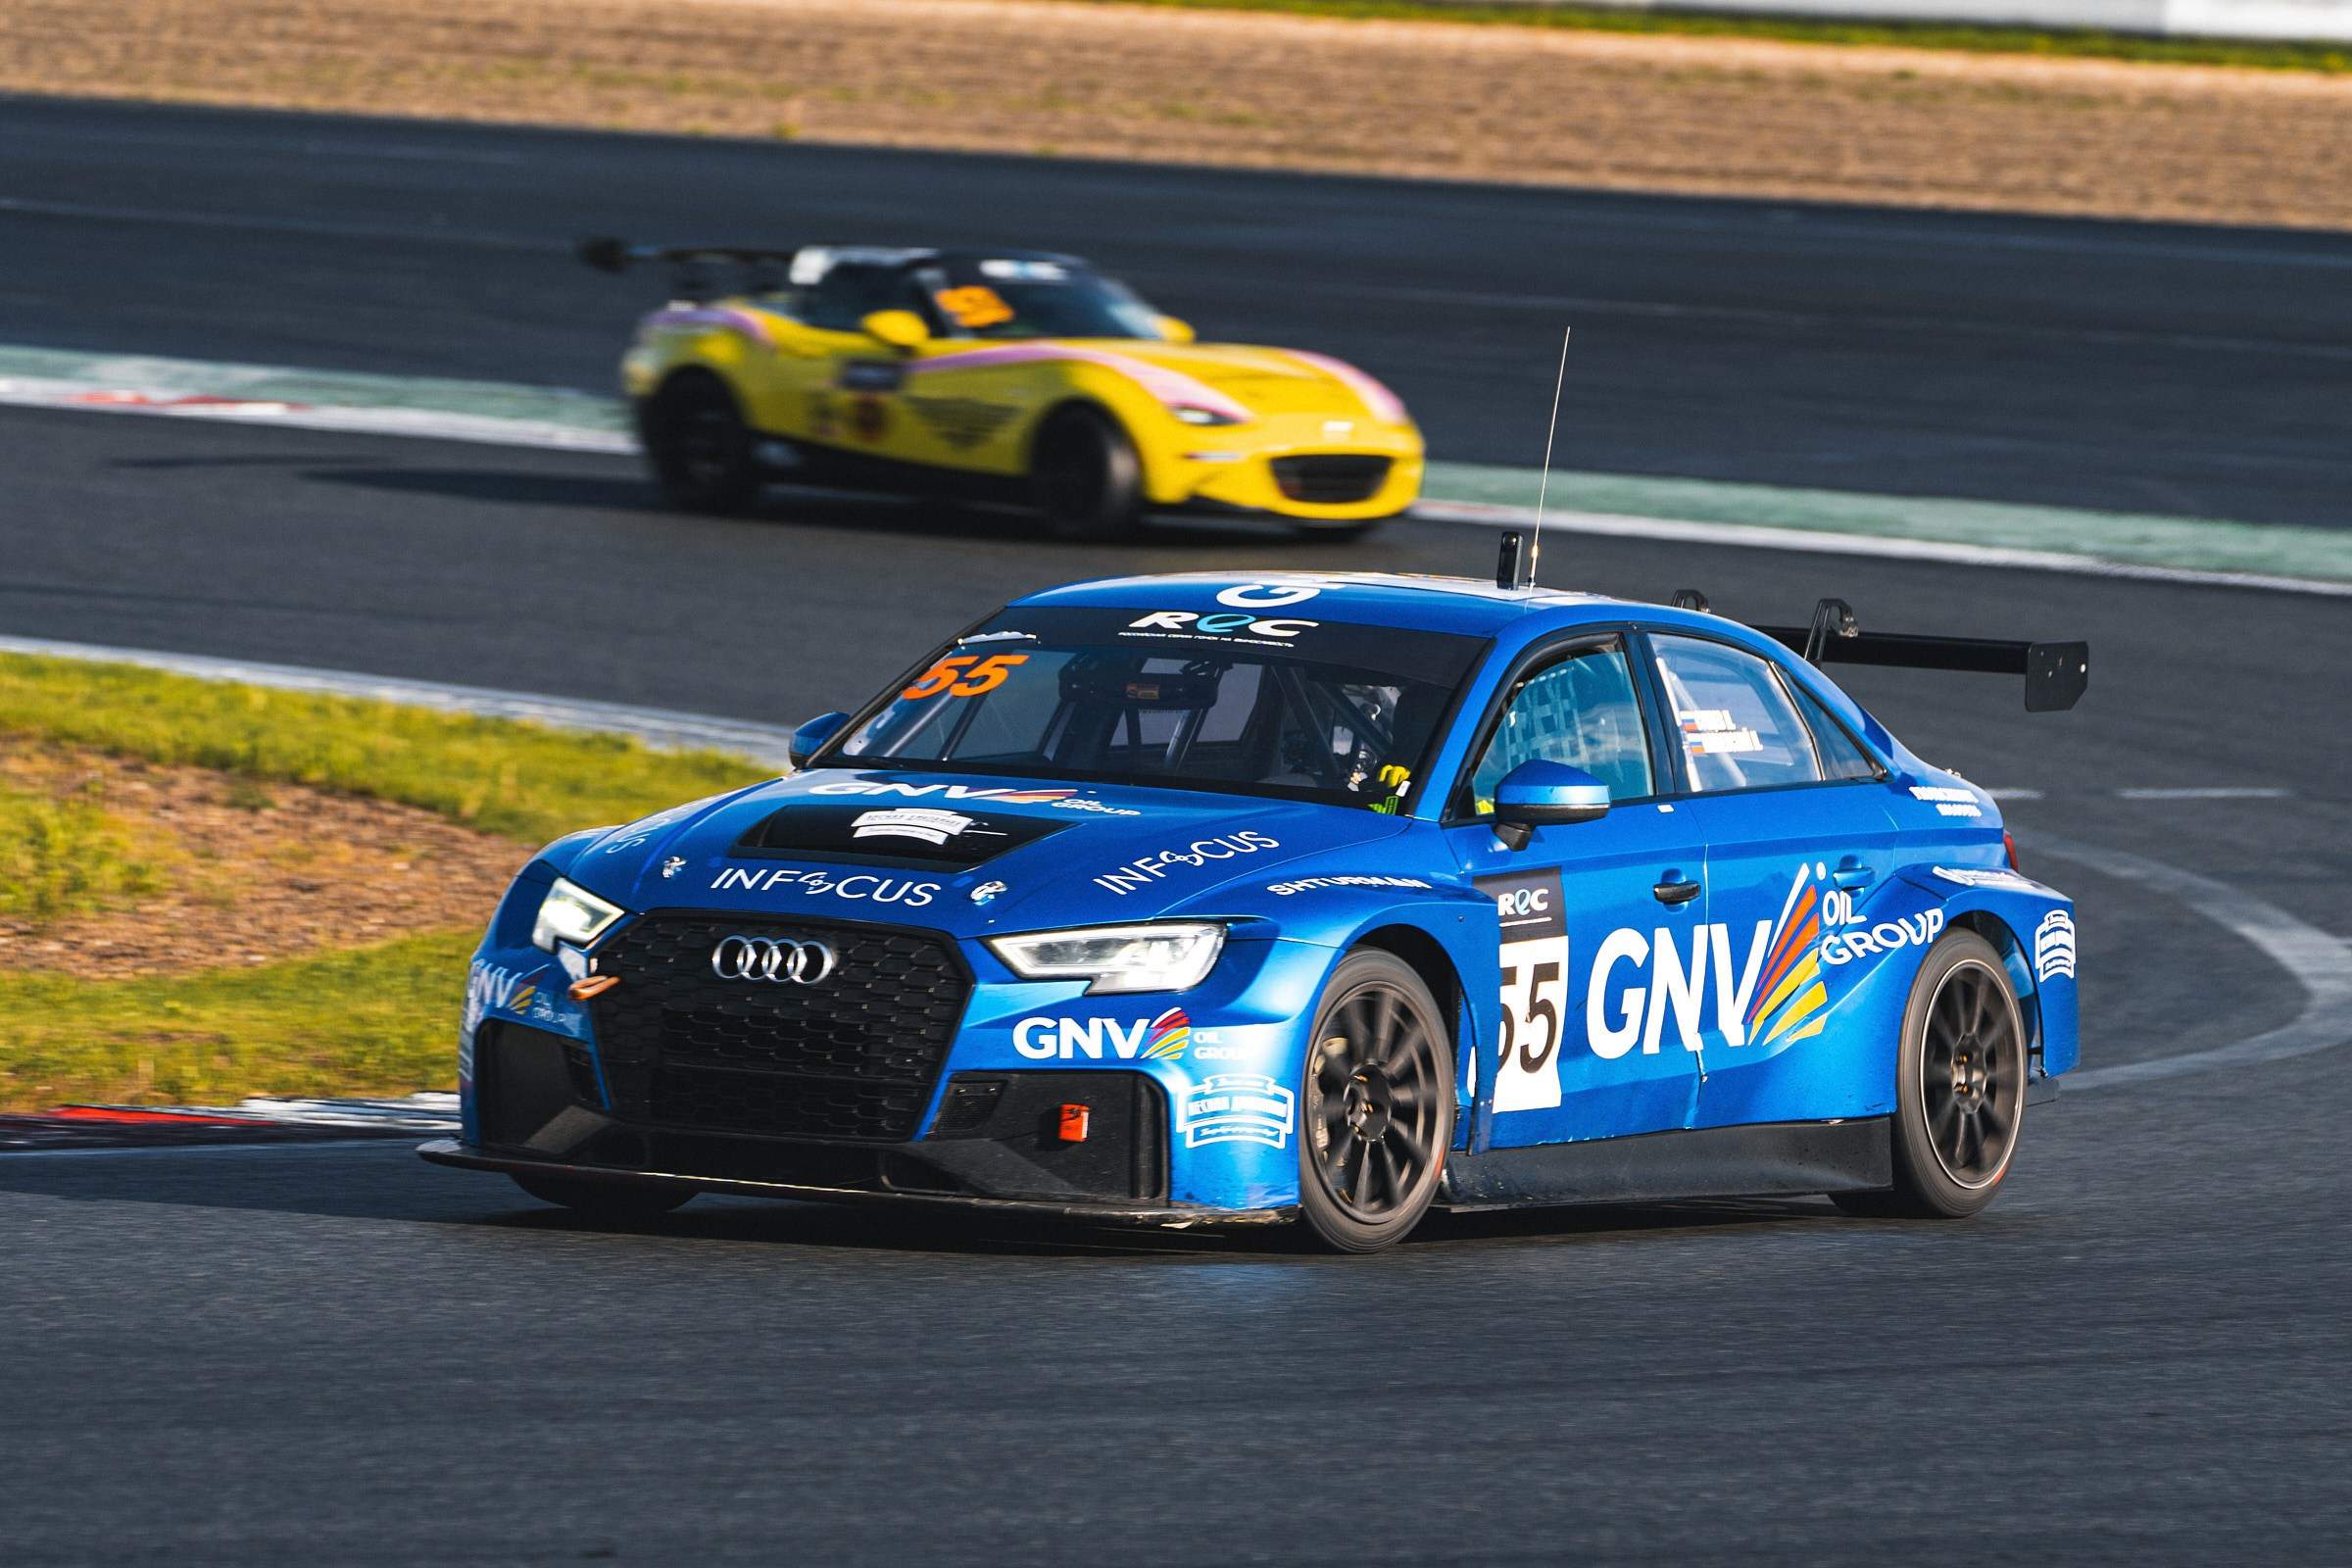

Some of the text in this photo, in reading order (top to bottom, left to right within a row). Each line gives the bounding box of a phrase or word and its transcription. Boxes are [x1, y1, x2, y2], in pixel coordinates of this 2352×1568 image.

[902, 655, 1030, 700] 55
[808, 782, 1016, 799] GNV
[1051, 802, 1142, 815] GROUP
[1266, 876, 1433, 896] SHTURMAN
[1822, 890, 1868, 927] OIL
[1820, 907, 1944, 965] GROUP
[1587, 919, 1773, 1059] GNV
[1012, 1016, 1151, 1059] GNV
[1194, 1031, 1224, 1044] OIL
